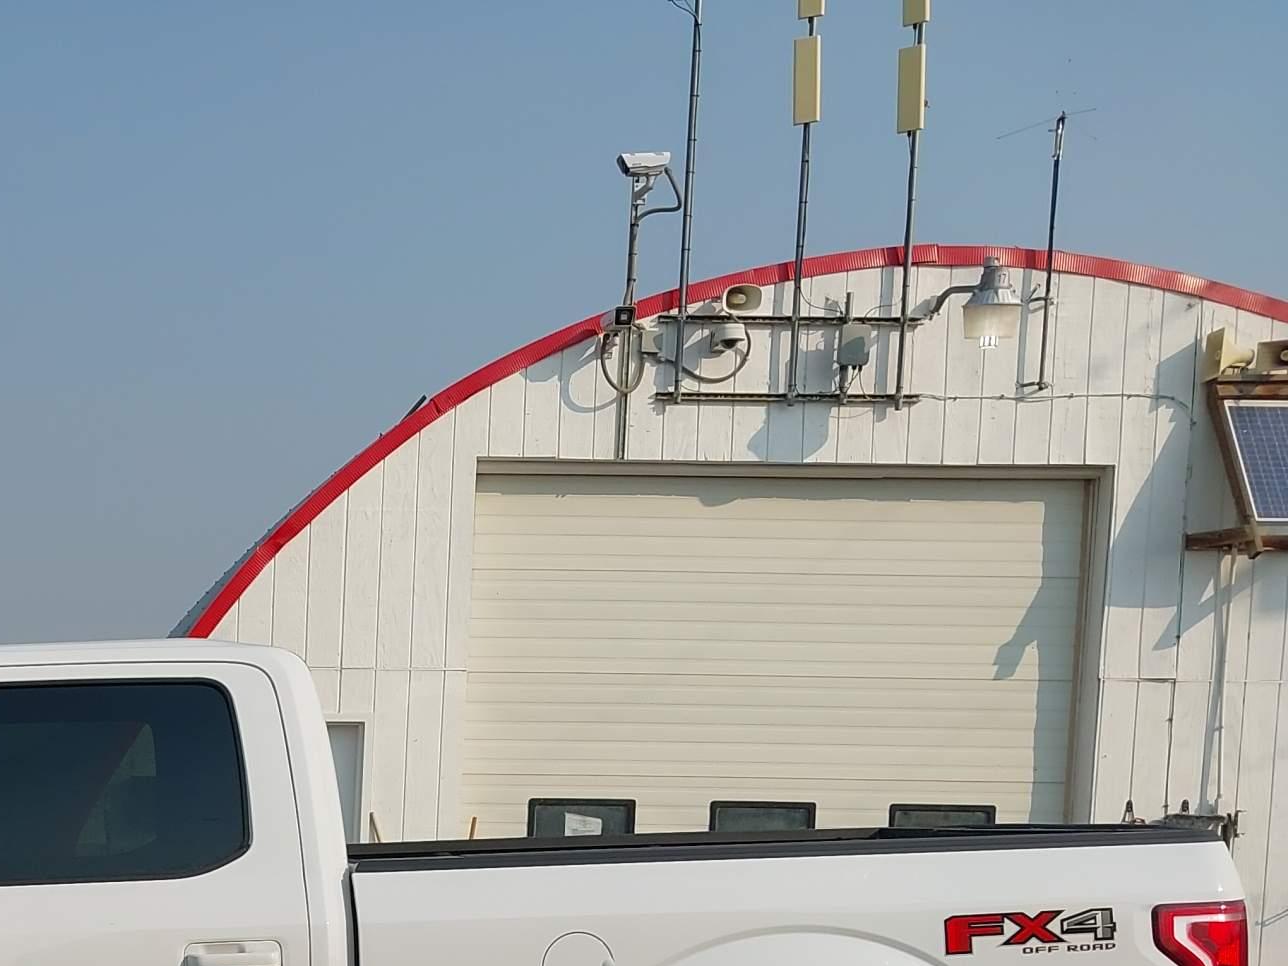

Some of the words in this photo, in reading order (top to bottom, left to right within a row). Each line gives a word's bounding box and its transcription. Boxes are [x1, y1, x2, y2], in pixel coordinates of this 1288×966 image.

[944, 908, 1117, 956] FX4
[1022, 945, 1059, 955] OFF
[1067, 943, 1117, 953] ROAD
